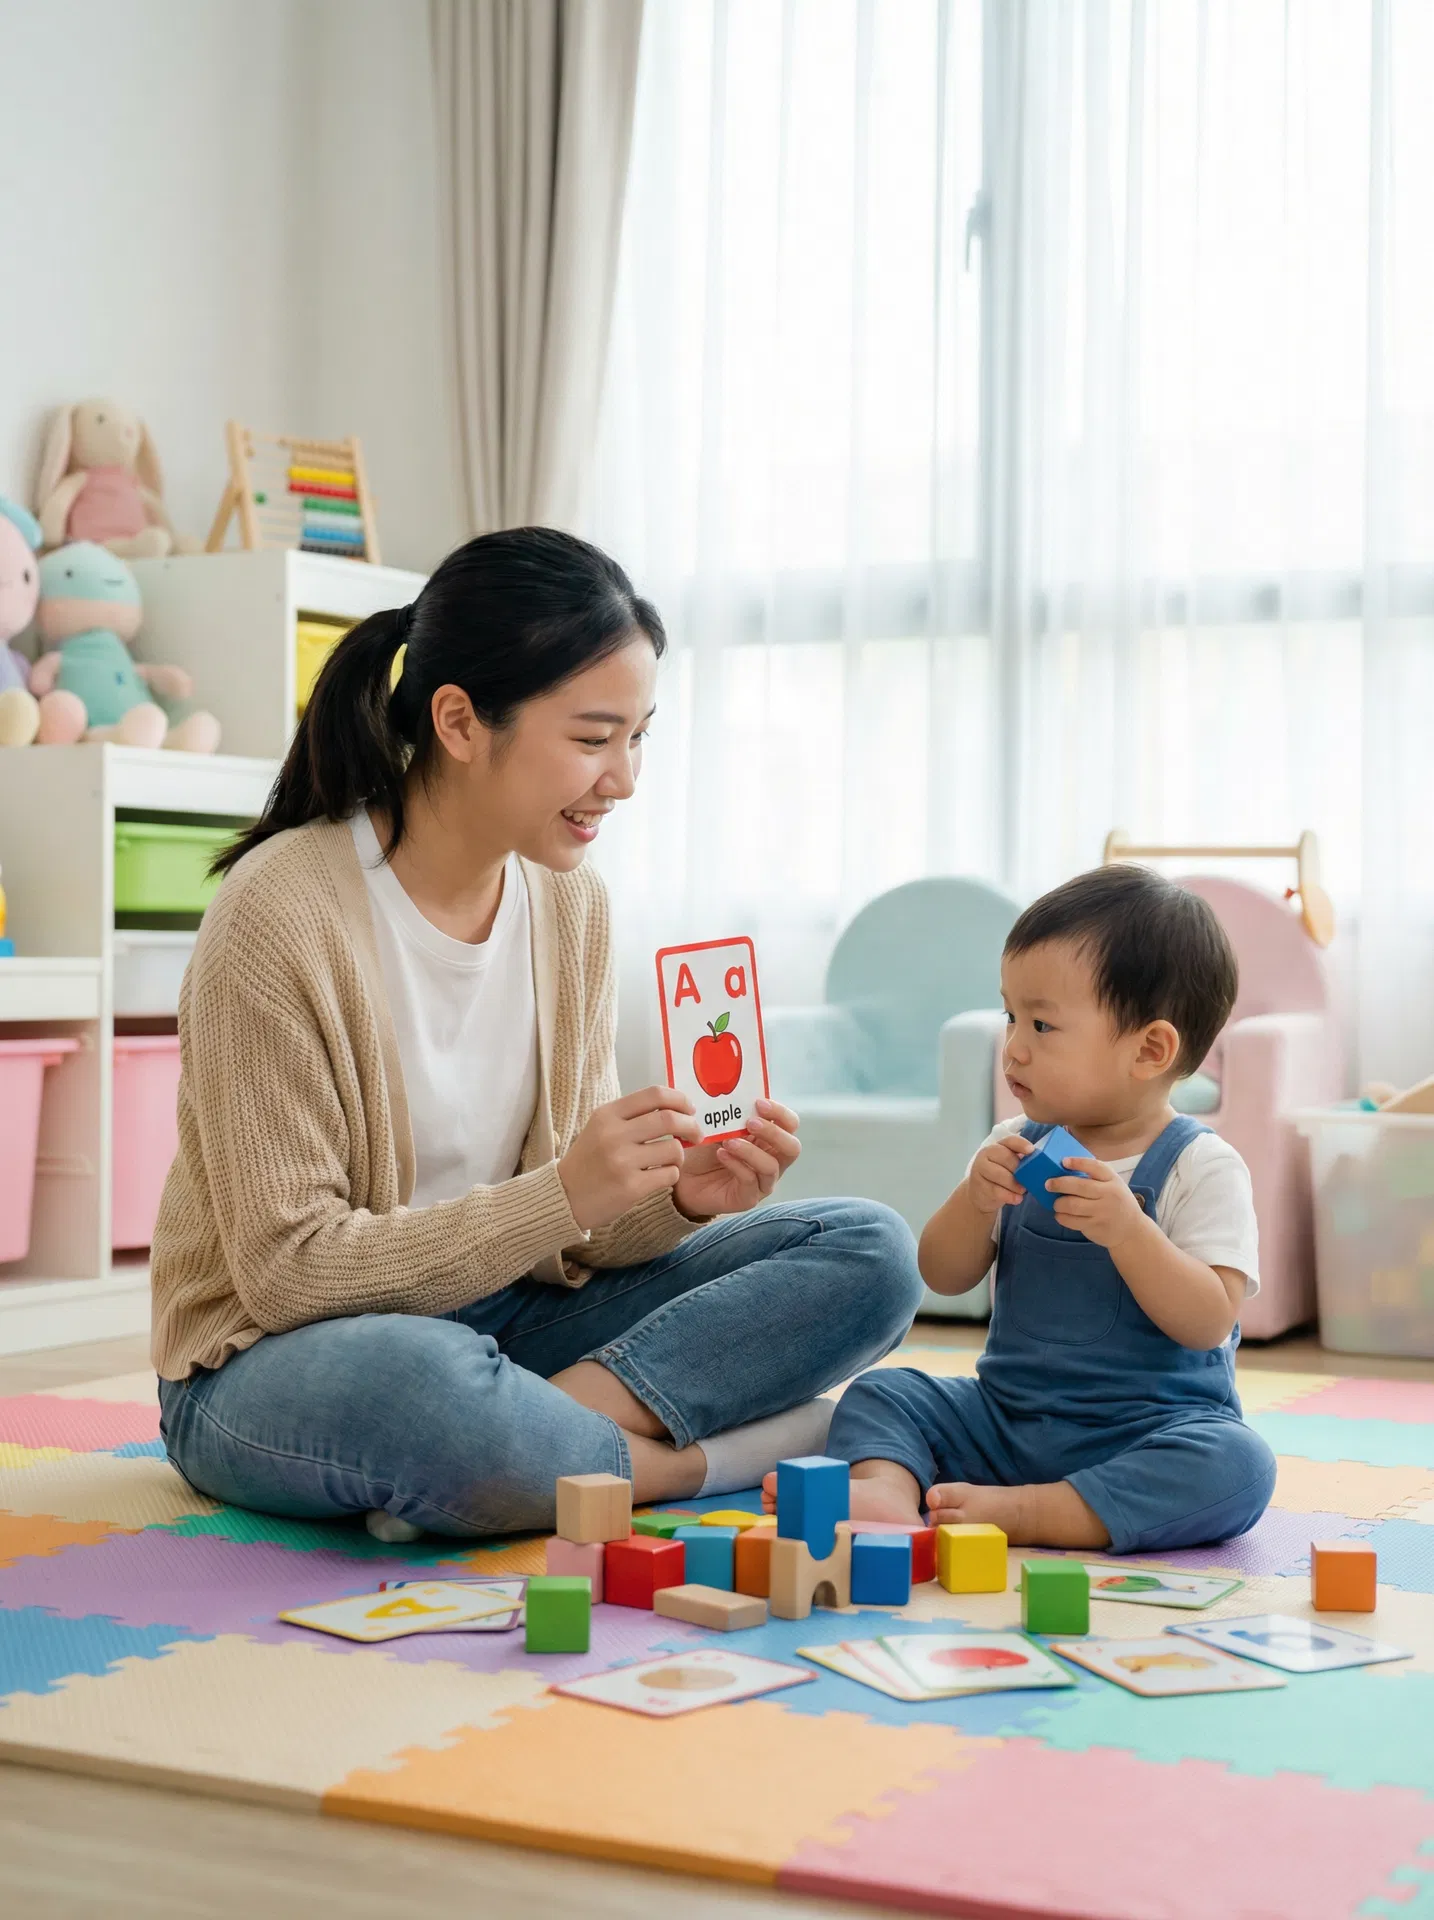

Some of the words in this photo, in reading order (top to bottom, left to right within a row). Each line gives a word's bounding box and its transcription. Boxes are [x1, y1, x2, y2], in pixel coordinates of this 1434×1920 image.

[674, 963, 702, 1008] A
[724, 965, 747, 999] a
[704, 1104, 742, 1128] apple
